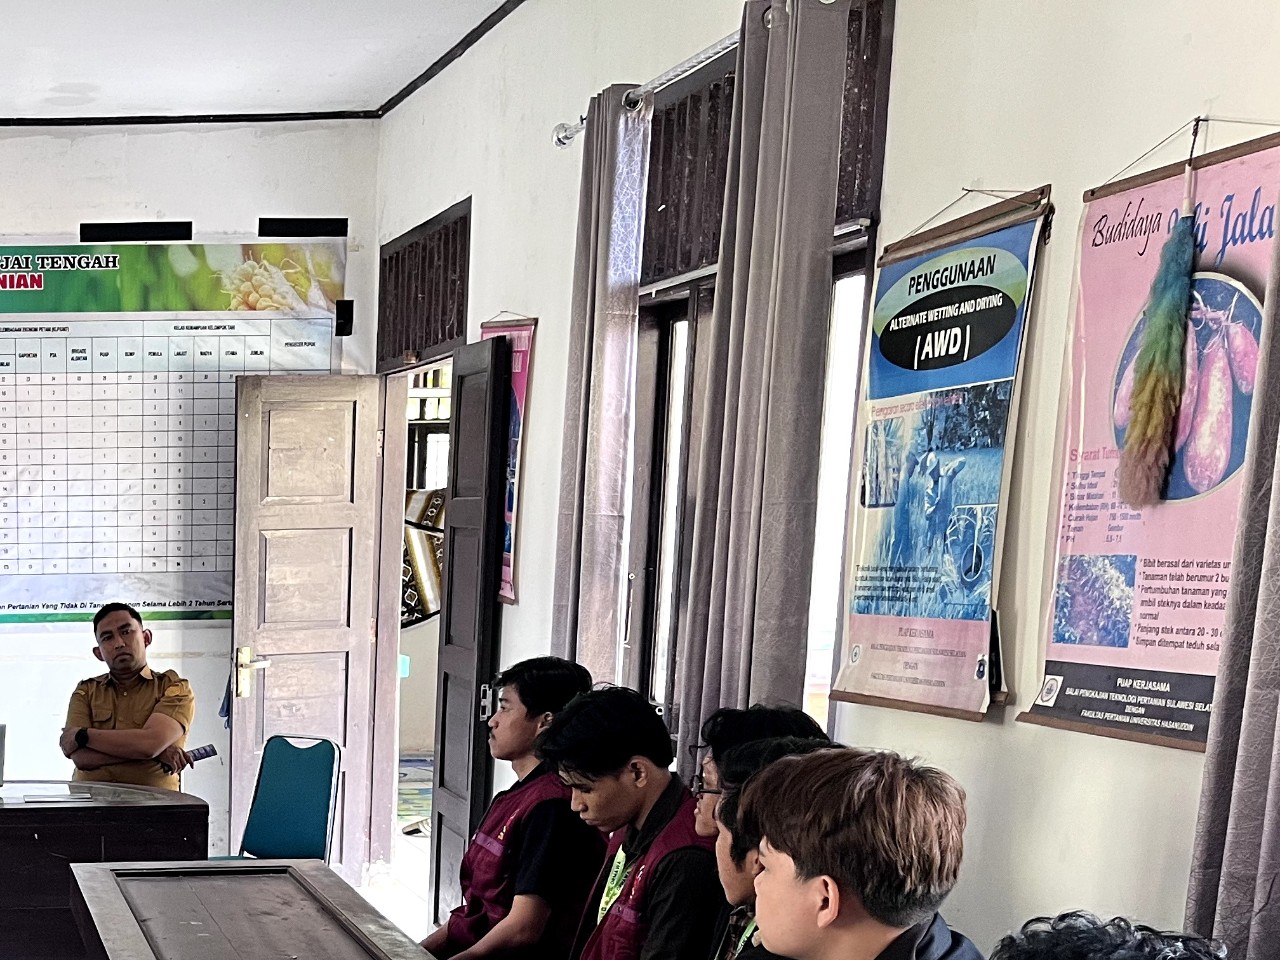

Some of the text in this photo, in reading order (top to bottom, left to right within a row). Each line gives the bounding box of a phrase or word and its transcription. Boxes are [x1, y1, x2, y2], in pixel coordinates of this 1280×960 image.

[1092, 198, 1162, 256] Budidaya
[36, 254, 119, 270] TENGAH
[908, 254, 996, 296] PENGGUNAAN
[890, 310, 927, 331] ALTERNATE
[927, 302, 959, 322] WETTING
[959, 299, 976, 315] AND
[1070, 449, 1100, 461] Sarat
[1157, 559, 1180, 568] berasal
[1181, 560, 1194, 568] dari
[1196, 560, 1221, 569] varietas
[1143, 572, 1167, 581] Tanaman
[1169, 573, 1184, 582] telah
[1186, 573, 1214, 582] berumur
[1215, 573, 1219, 582] 2
[1141, 585, 1227, 599] Pertumbuhan tanaman yang
[41, 603, 58, 611] Yang
[1157, 599, 1180, 610] steknya
[1182, 600, 1202, 609] dalam
[1137, 623, 1159, 636] Panjang
[1161, 625, 1173, 635] stek
[1175, 626, 1195, 636] antara
[1197, 627, 1204, 637] 20
[1211, 628, 1218, 637] 30
[1136, 637, 1156, 648] Simpan
[1185, 640, 1204, 650] teduh
[1117, 678, 1170, 692] PUAP KERJASAMA
[1108, 693, 1136, 703] TEKNOLOGI
[1137, 696, 1166, 707] PERTANIAN
[1166, 699, 1194, 710] SULAWESI
[1125, 705, 1145, 714] DENGAN
[1081, 709, 1104, 719] FAKULTAS
[1104, 712, 1129, 722] PERTANIAN
[1130, 716, 1161, 726] UNIVERSITAS
